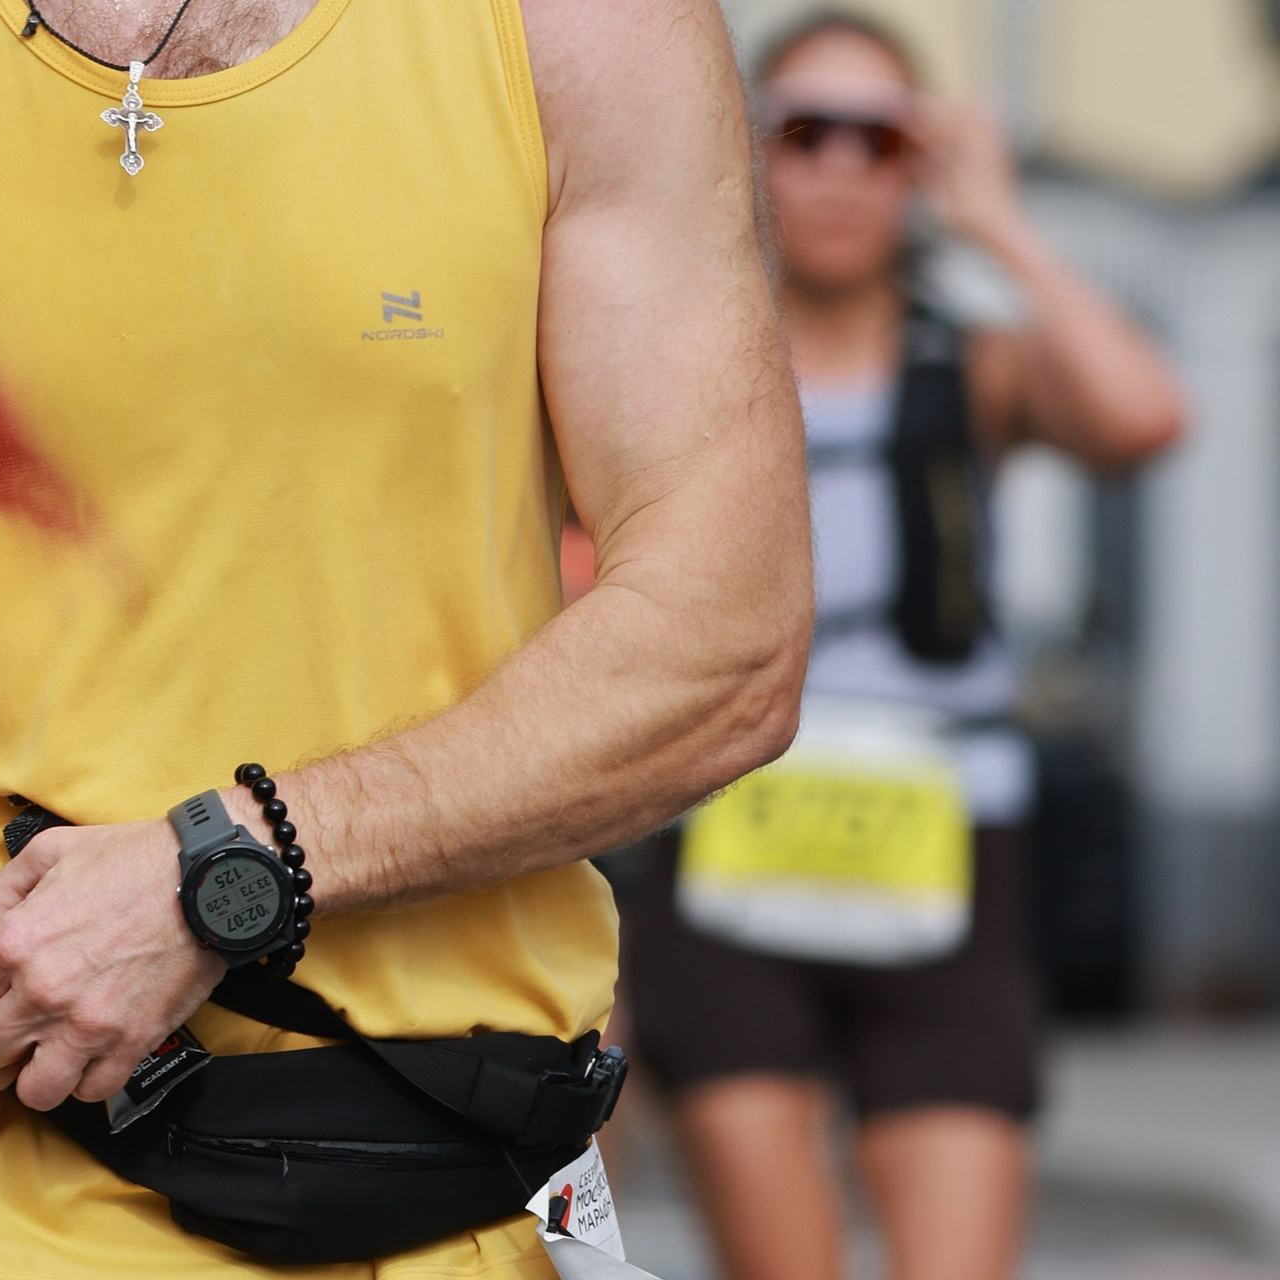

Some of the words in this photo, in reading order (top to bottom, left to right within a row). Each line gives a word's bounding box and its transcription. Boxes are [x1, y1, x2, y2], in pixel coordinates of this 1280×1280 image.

[361, 328, 445, 341] NORDSKI
[215, 867, 242, 889] 125
[240, 875, 271, 897] 33.73
[206, 895, 230, 913] 5:20
[227, 904, 266, 933] 02:07
[141, 1050, 187, 1089] ACADEMY-T
